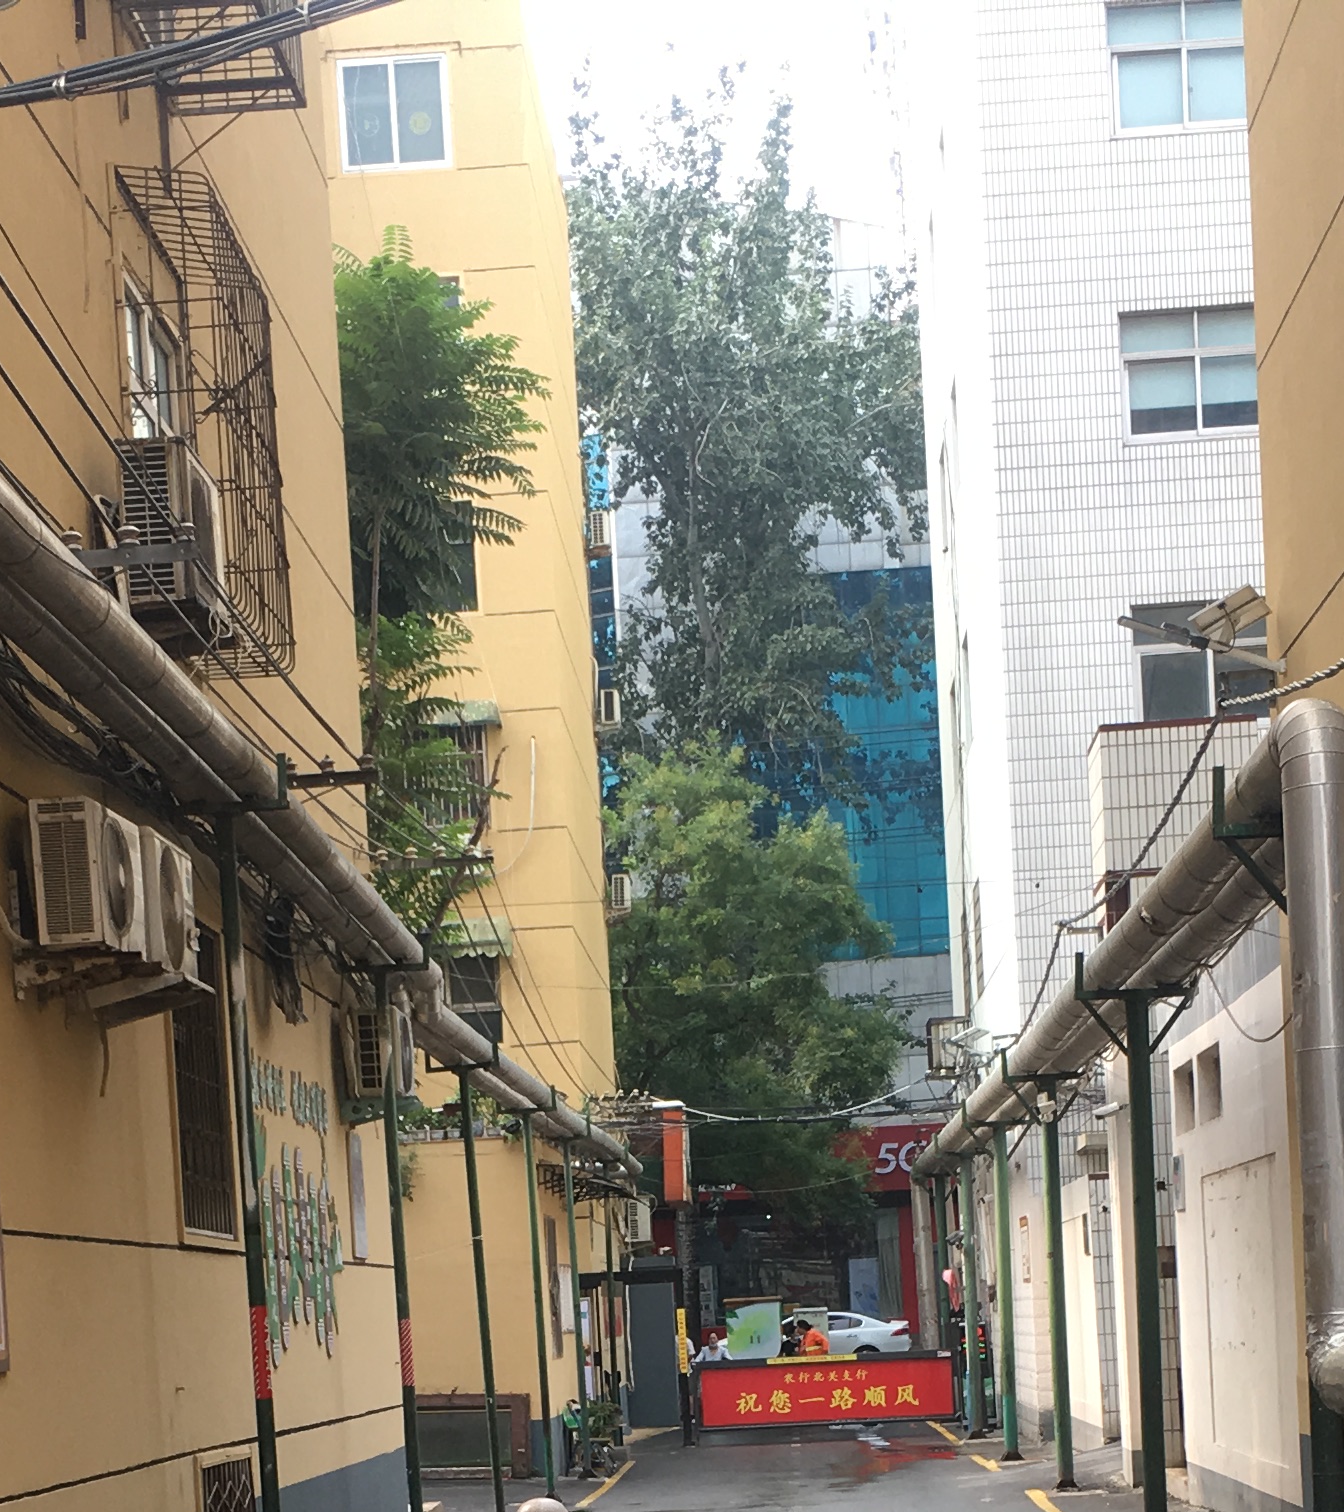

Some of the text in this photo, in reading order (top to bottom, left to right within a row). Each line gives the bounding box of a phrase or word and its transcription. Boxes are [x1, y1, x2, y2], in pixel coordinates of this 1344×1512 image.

[736, 1384, 919, 1414] 祝您一路顺风
